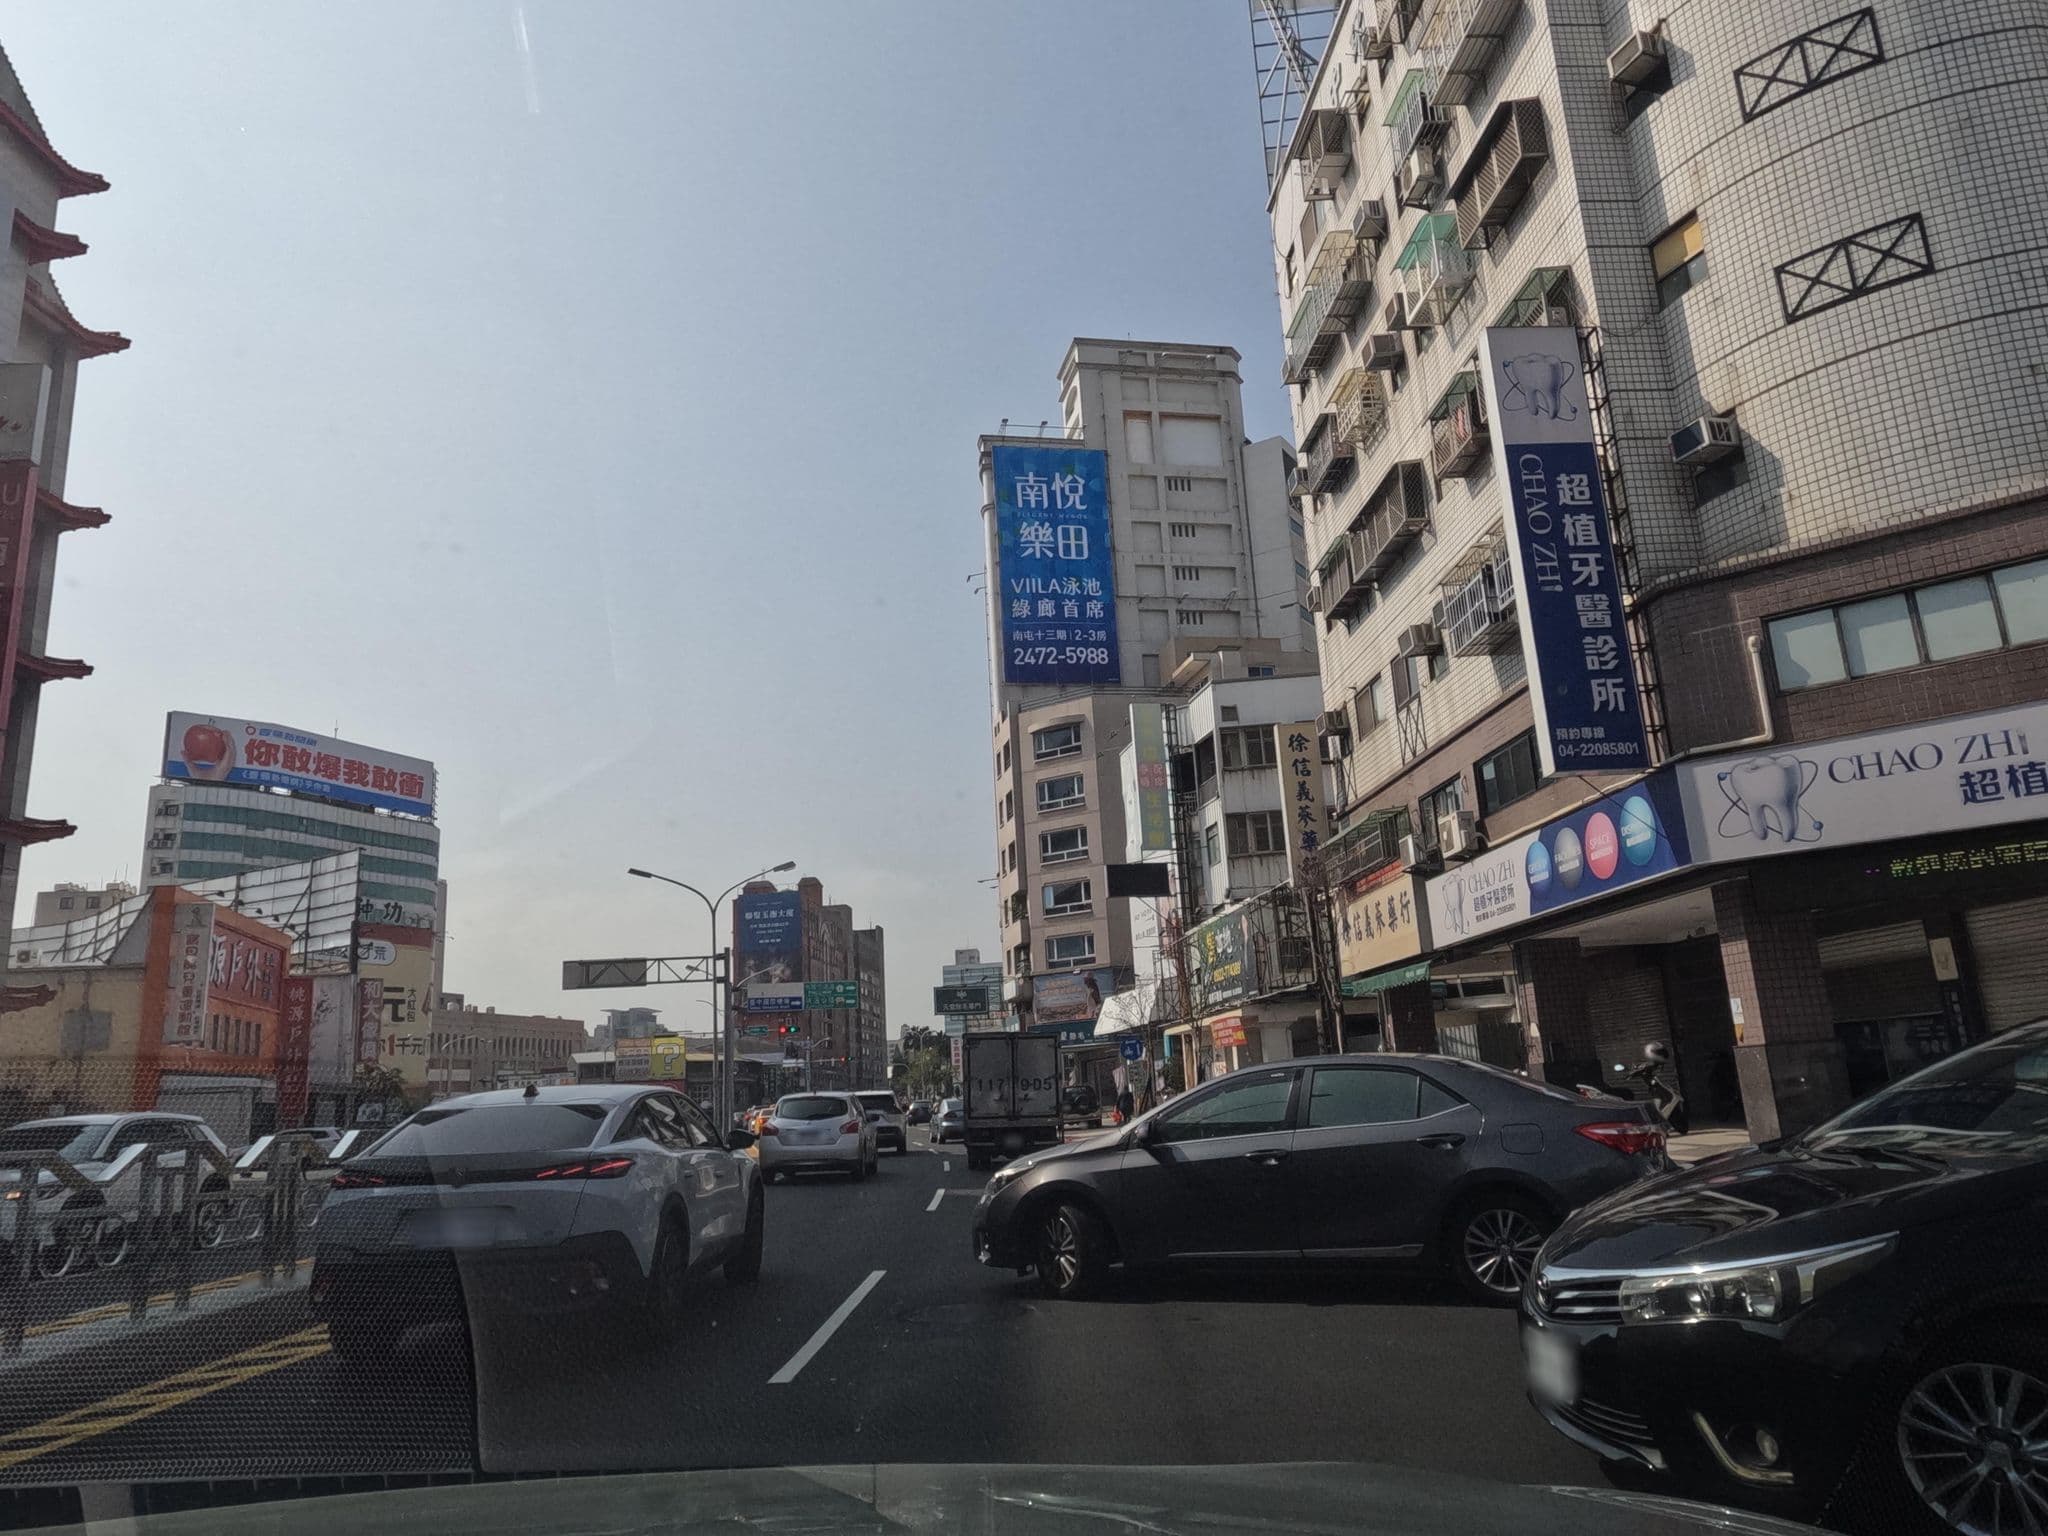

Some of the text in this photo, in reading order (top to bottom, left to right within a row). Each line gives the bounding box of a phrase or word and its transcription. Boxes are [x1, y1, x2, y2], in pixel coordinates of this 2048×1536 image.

[1014, 471, 1088, 511] 南悅
[1519, 453, 1553, 535] CHAO
[1019, 521, 1089, 560] 樂田
[1011, 598, 1104, 619] 綠廊首席
[1556, 472, 1627, 713] 超植牙醫診所
[1013, 646, 1109, 665] 2472-5988
[244, 738, 425, 799] 你敢爆我敢衝
[1558, 742, 1640, 757] 04-22085801
[1828, 741, 1944, 784] CHAO
[406, 988, 417, 1023] 大紅包
